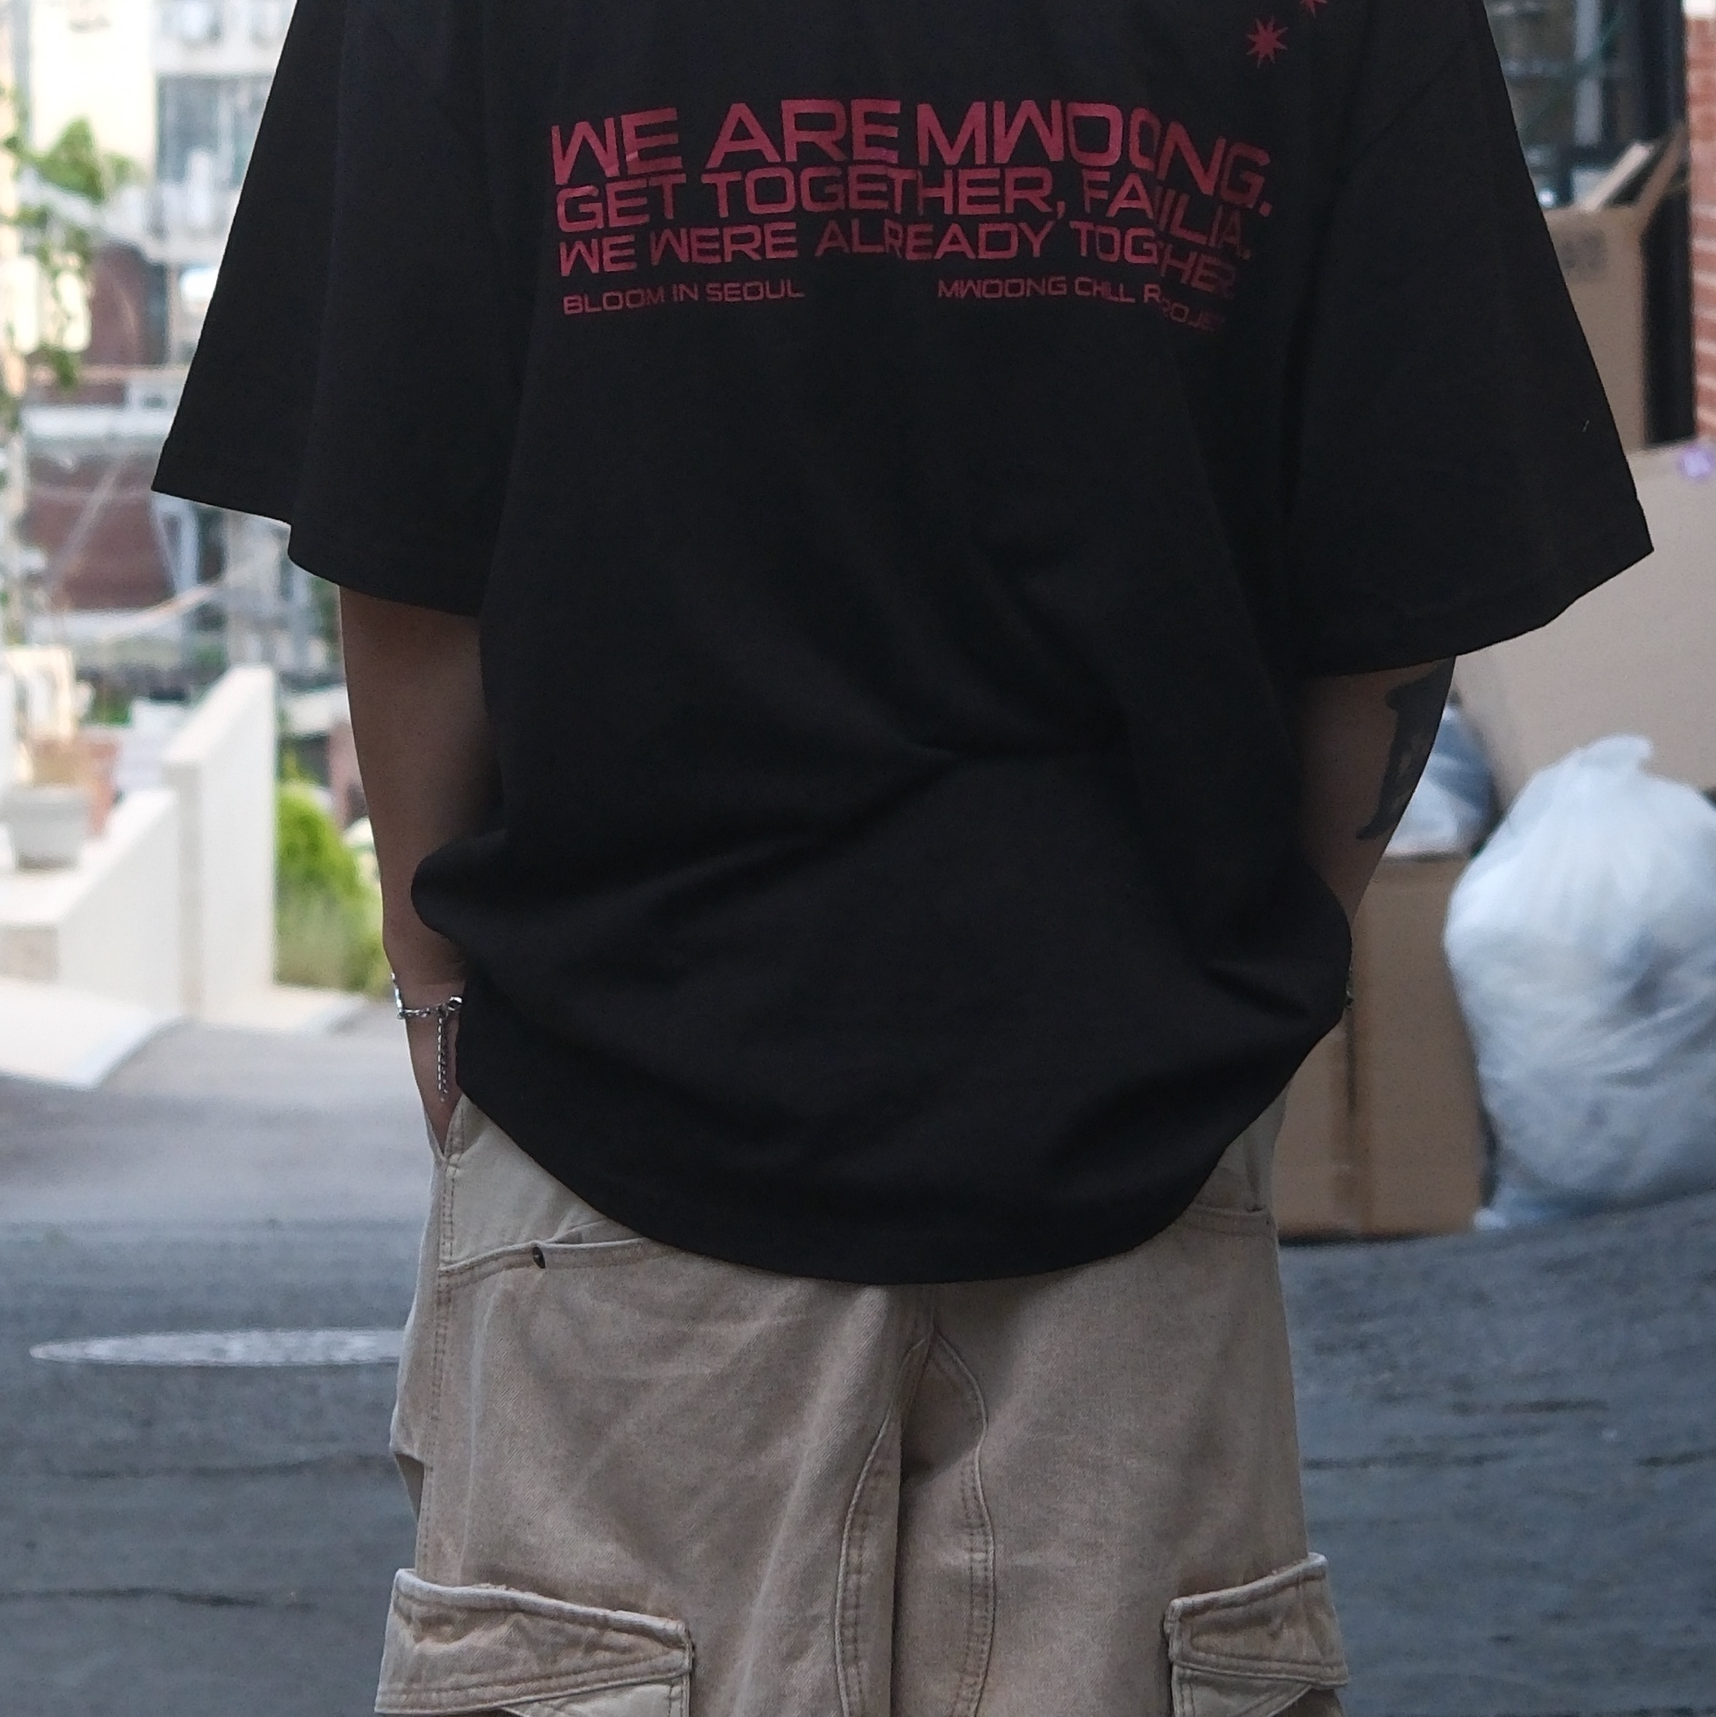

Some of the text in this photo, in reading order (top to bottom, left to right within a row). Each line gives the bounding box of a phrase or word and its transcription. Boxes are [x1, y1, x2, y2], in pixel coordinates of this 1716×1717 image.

[550, 97, 1275, 218] WE ARE MWOONG.
[555, 171, 687, 234] GET
[700, 163, 1067, 220] TOGETHER,
[558, 232, 638, 278] WE
[649, 220, 799, 268] WERE
[813, 218, 1057, 263] ALREADY
[562, 278, 806, 316] BLOOM IN SEOUL
[936, 275, 1068, 300] MWOONG
[1073, 275, 1136, 304] CHILL
